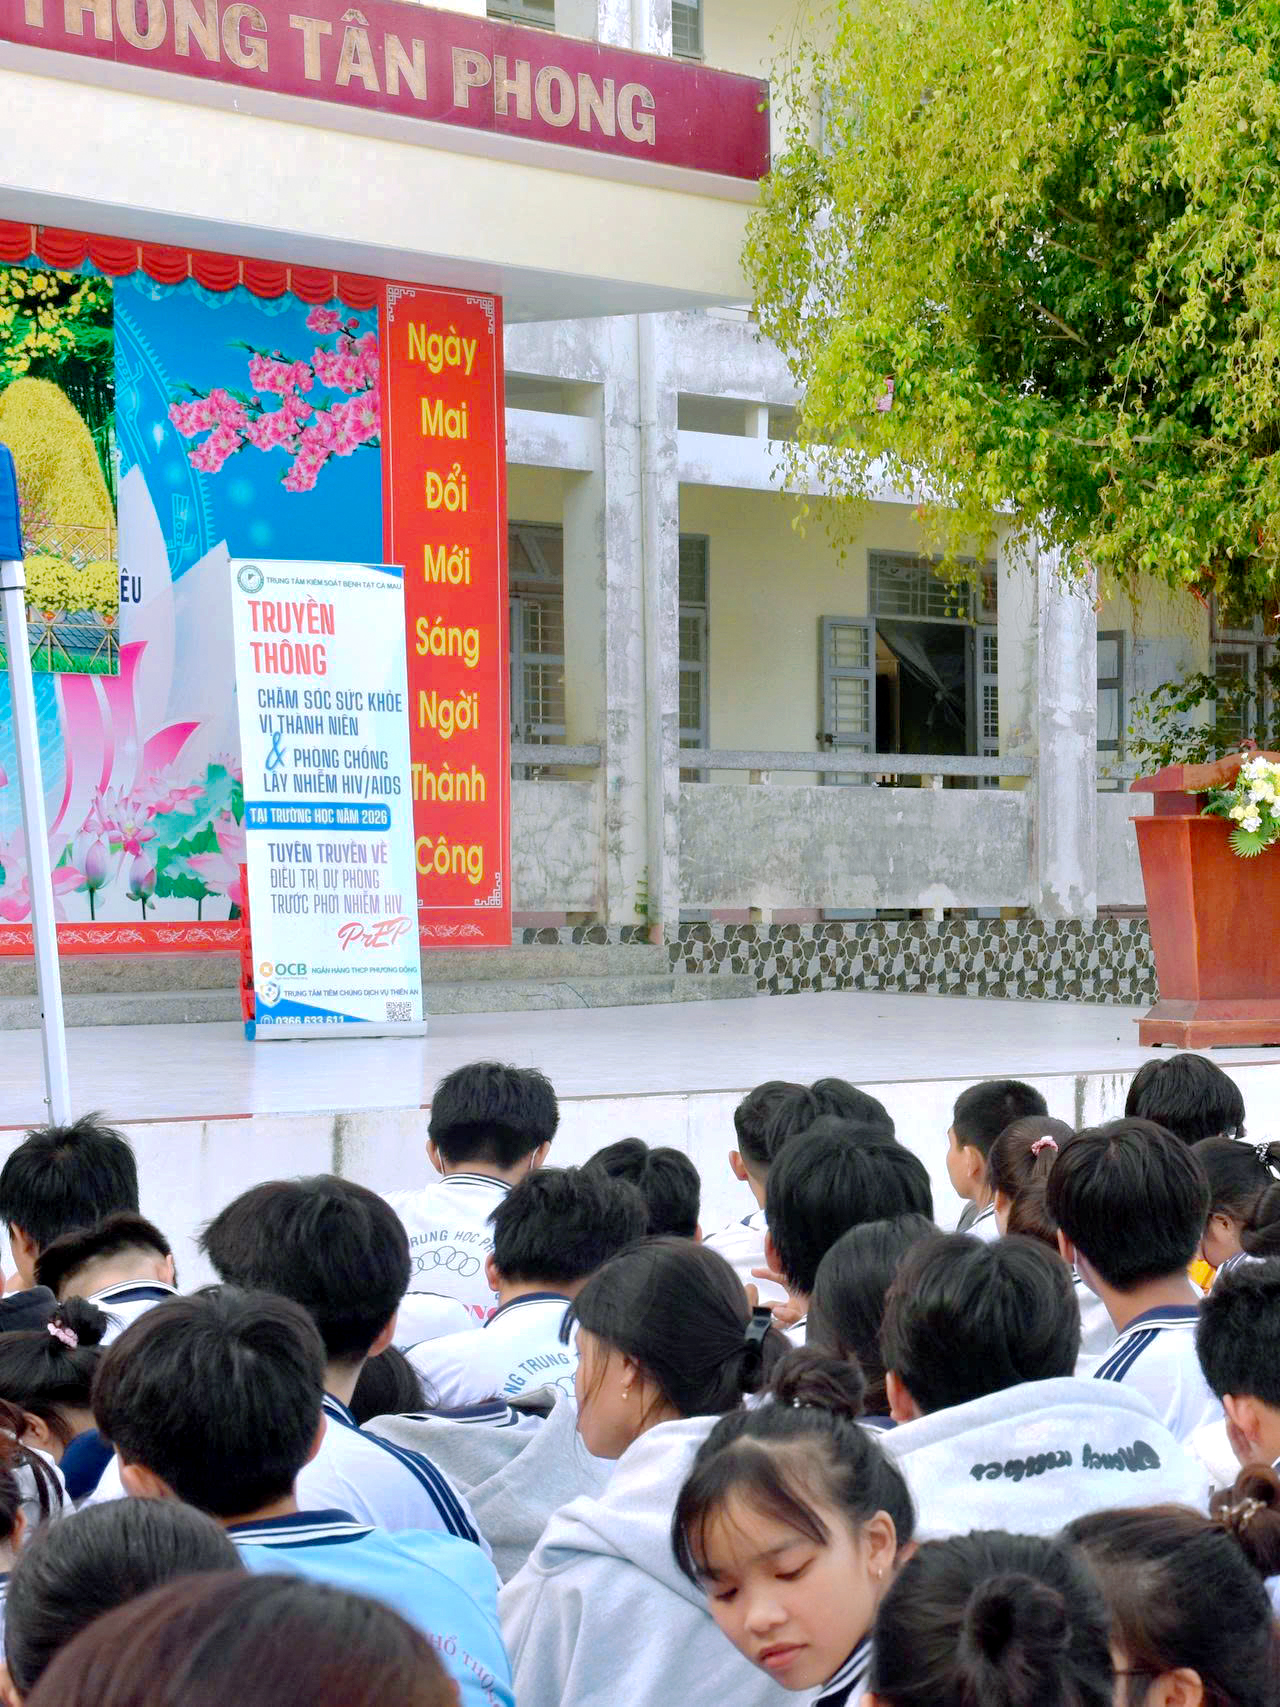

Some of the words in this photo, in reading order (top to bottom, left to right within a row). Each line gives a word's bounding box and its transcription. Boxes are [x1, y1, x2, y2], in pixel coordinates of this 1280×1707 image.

[289, 9, 428, 101] TÂN
[452, 47, 657, 146] PHONG
[408, 322, 477, 376] Ngày
[420, 397, 468, 439] Mai
[425, 463, 467, 512] Đổi
[266, 576, 290, 585] TRUNG
[424, 544, 471, 585] Mới
[120, 567, 142, 604] ÊU
[247, 593, 335, 635] TRUYỀN
[250, 638, 327, 676] THÔNG
[415, 616, 480, 668] Sáng
[258, 686, 299, 710] CHĂM
[304, 687, 332, 711] SÓC
[336, 688, 364, 711] SỨC
[418, 690, 478, 739] Ngời
[259, 713, 273, 737] VỊ
[277, 712, 325, 735] THÀNH
[328, 713, 359, 736] NIÊN
[344, 744, 389, 770] CHỐNG
[293, 769, 338, 795] NHIỄM
[342, 774, 402, 799] HIV/AIDS
[411, 762, 486, 802] Thành
[249, 807, 268, 825] TẠI
[270, 806, 312, 824] TRƯỜNG
[314, 807, 335, 826] HỌC
[336, 807, 360, 825] NĂM
[361, 809, 388, 825] 2026
[268, 840, 313, 864] TUYÊN
[316, 838, 368, 865] TRUYỀN
[415, 836, 484, 884] Công
[270, 865, 296, 889] ĐIỀU
[300, 868, 319, 891] TRỊ
[271, 891, 309, 914] TRƯỚC
[384, 894, 402, 914] HIV
[338, 916, 413, 951] PrEP
[275, 963, 307, 976] OCB
[410, 1229, 449, 1248] RUNG
[478, 1237, 495, 1253] PH
[517, 1352, 570, 1376] TRUNG
